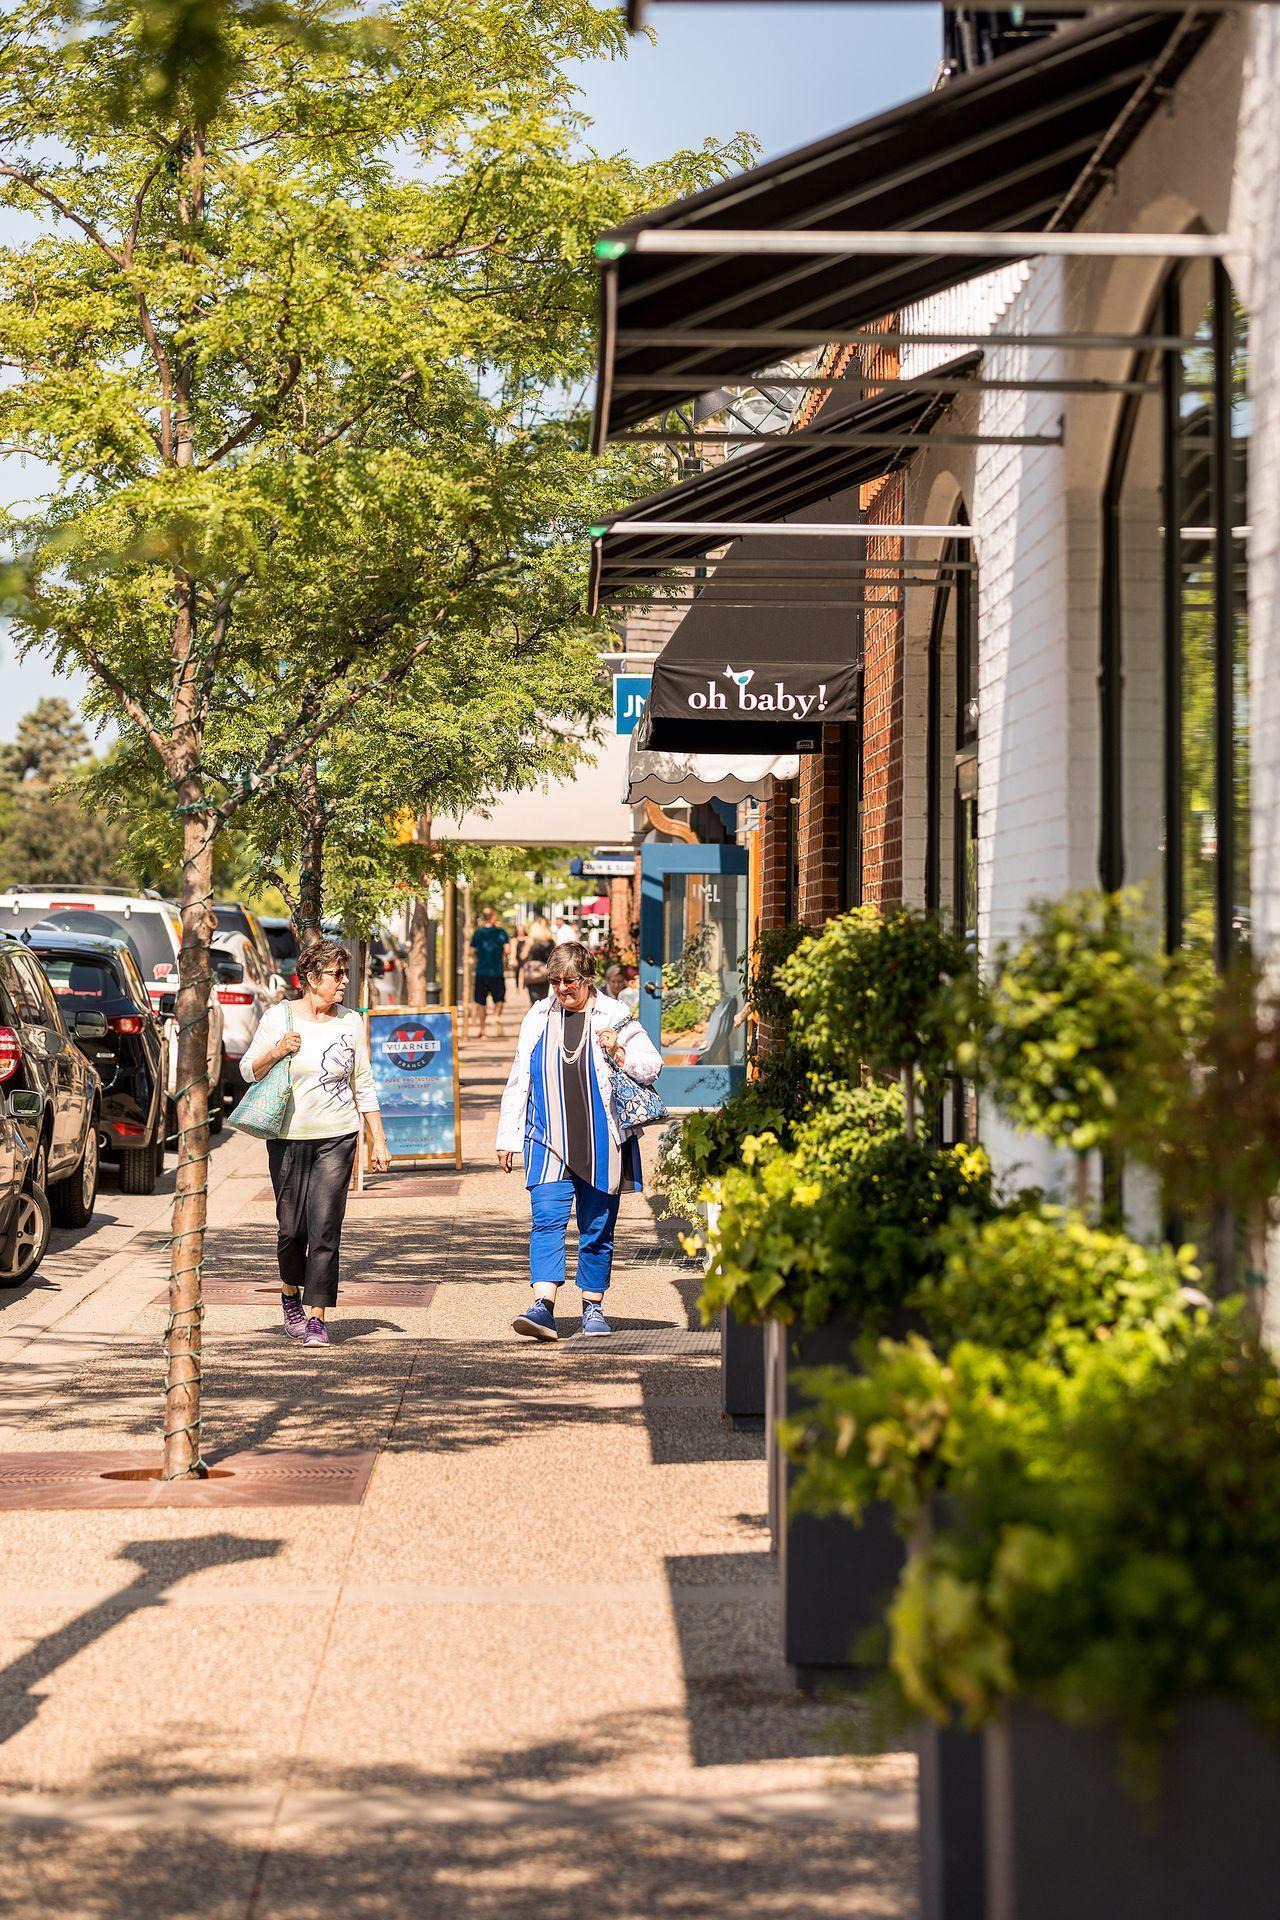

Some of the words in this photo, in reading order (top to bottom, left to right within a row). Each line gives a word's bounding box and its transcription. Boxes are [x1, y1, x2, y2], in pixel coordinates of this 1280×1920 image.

[687, 681, 728, 711] oh
[738, 682, 829, 720] baby!
[386, 1042, 437, 1051] VUARNET
[397, 1060, 426, 1069] FRANCE
